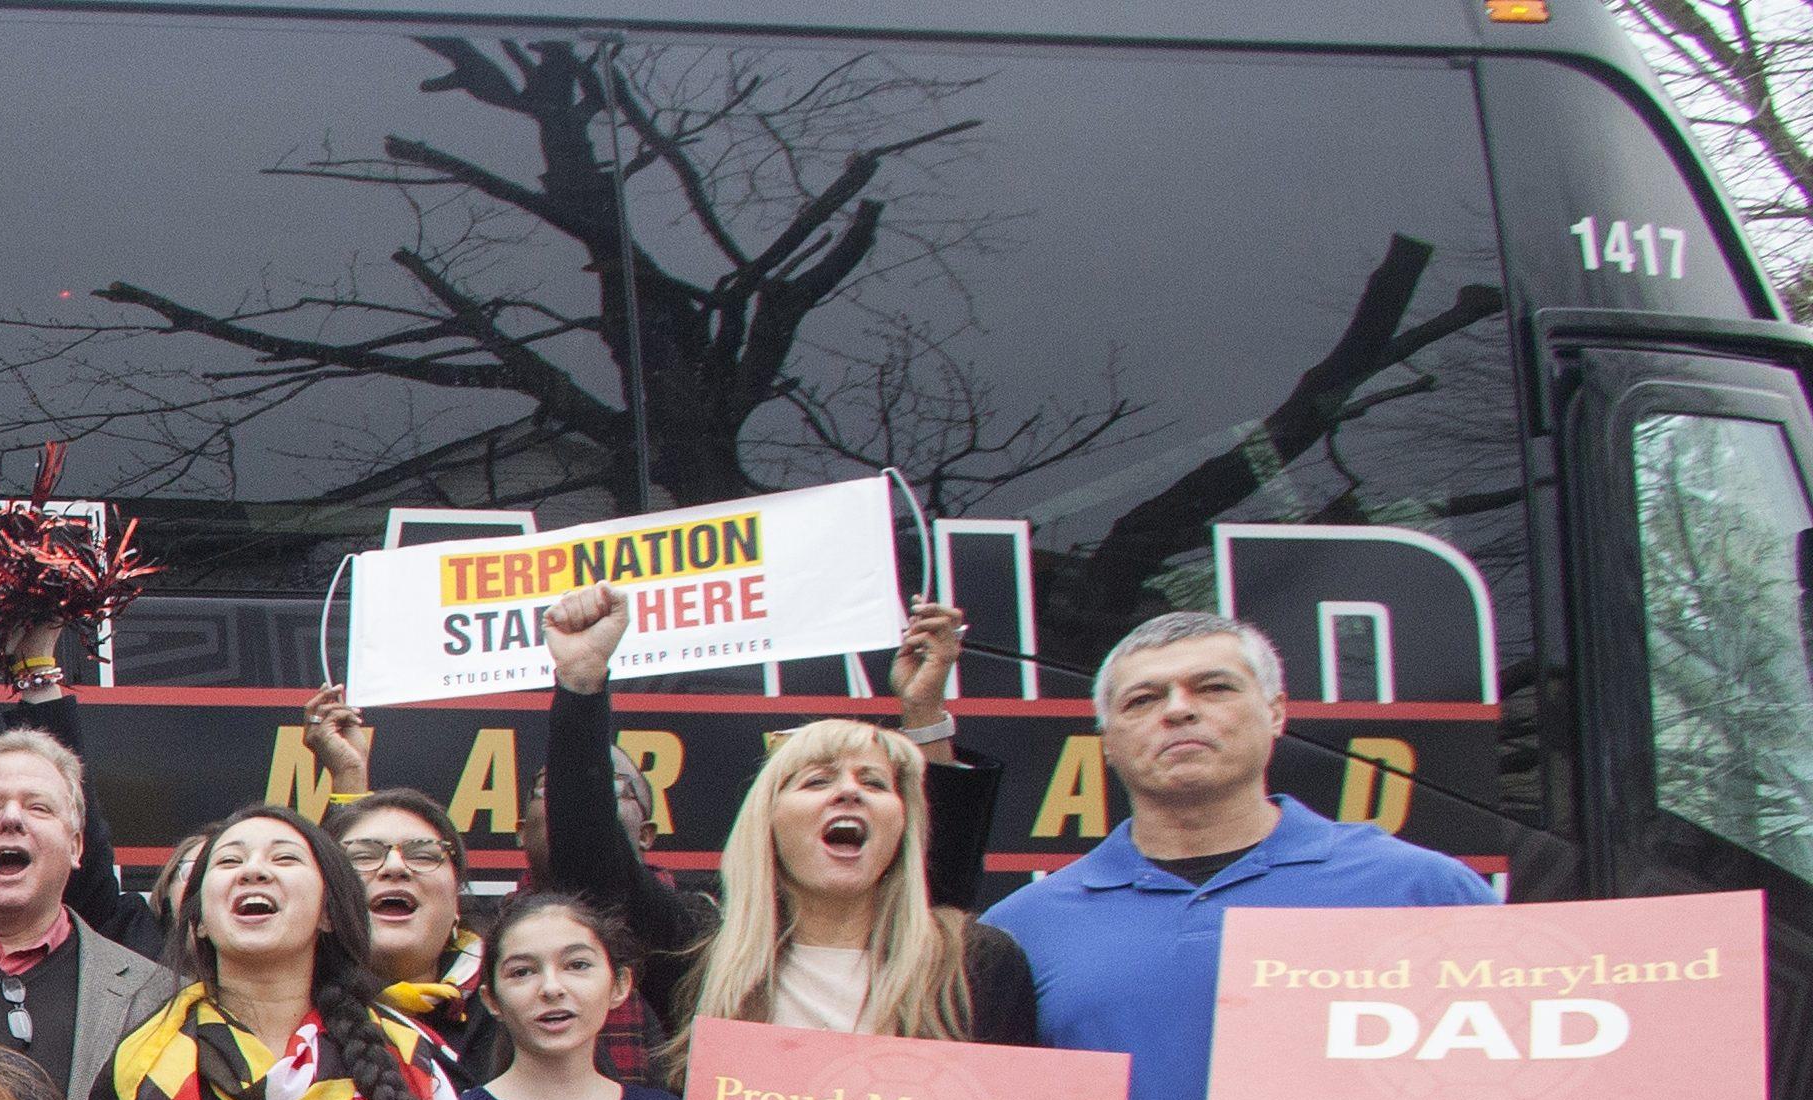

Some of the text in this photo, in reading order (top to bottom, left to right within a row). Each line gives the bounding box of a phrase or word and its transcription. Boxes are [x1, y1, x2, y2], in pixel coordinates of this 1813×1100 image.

[1570, 215, 1687, 280] 1417
[448, 516, 758, 601] TERPNATION
[637, 574, 768, 634] HERE
[443, 667, 526, 686] STUDENT
[620, 651, 669, 667] TERP
[682, 638, 773, 660] FOREVER
[1252, 947, 1722, 997] Proud Maryland
[1326, 998, 1630, 1060] DAD
